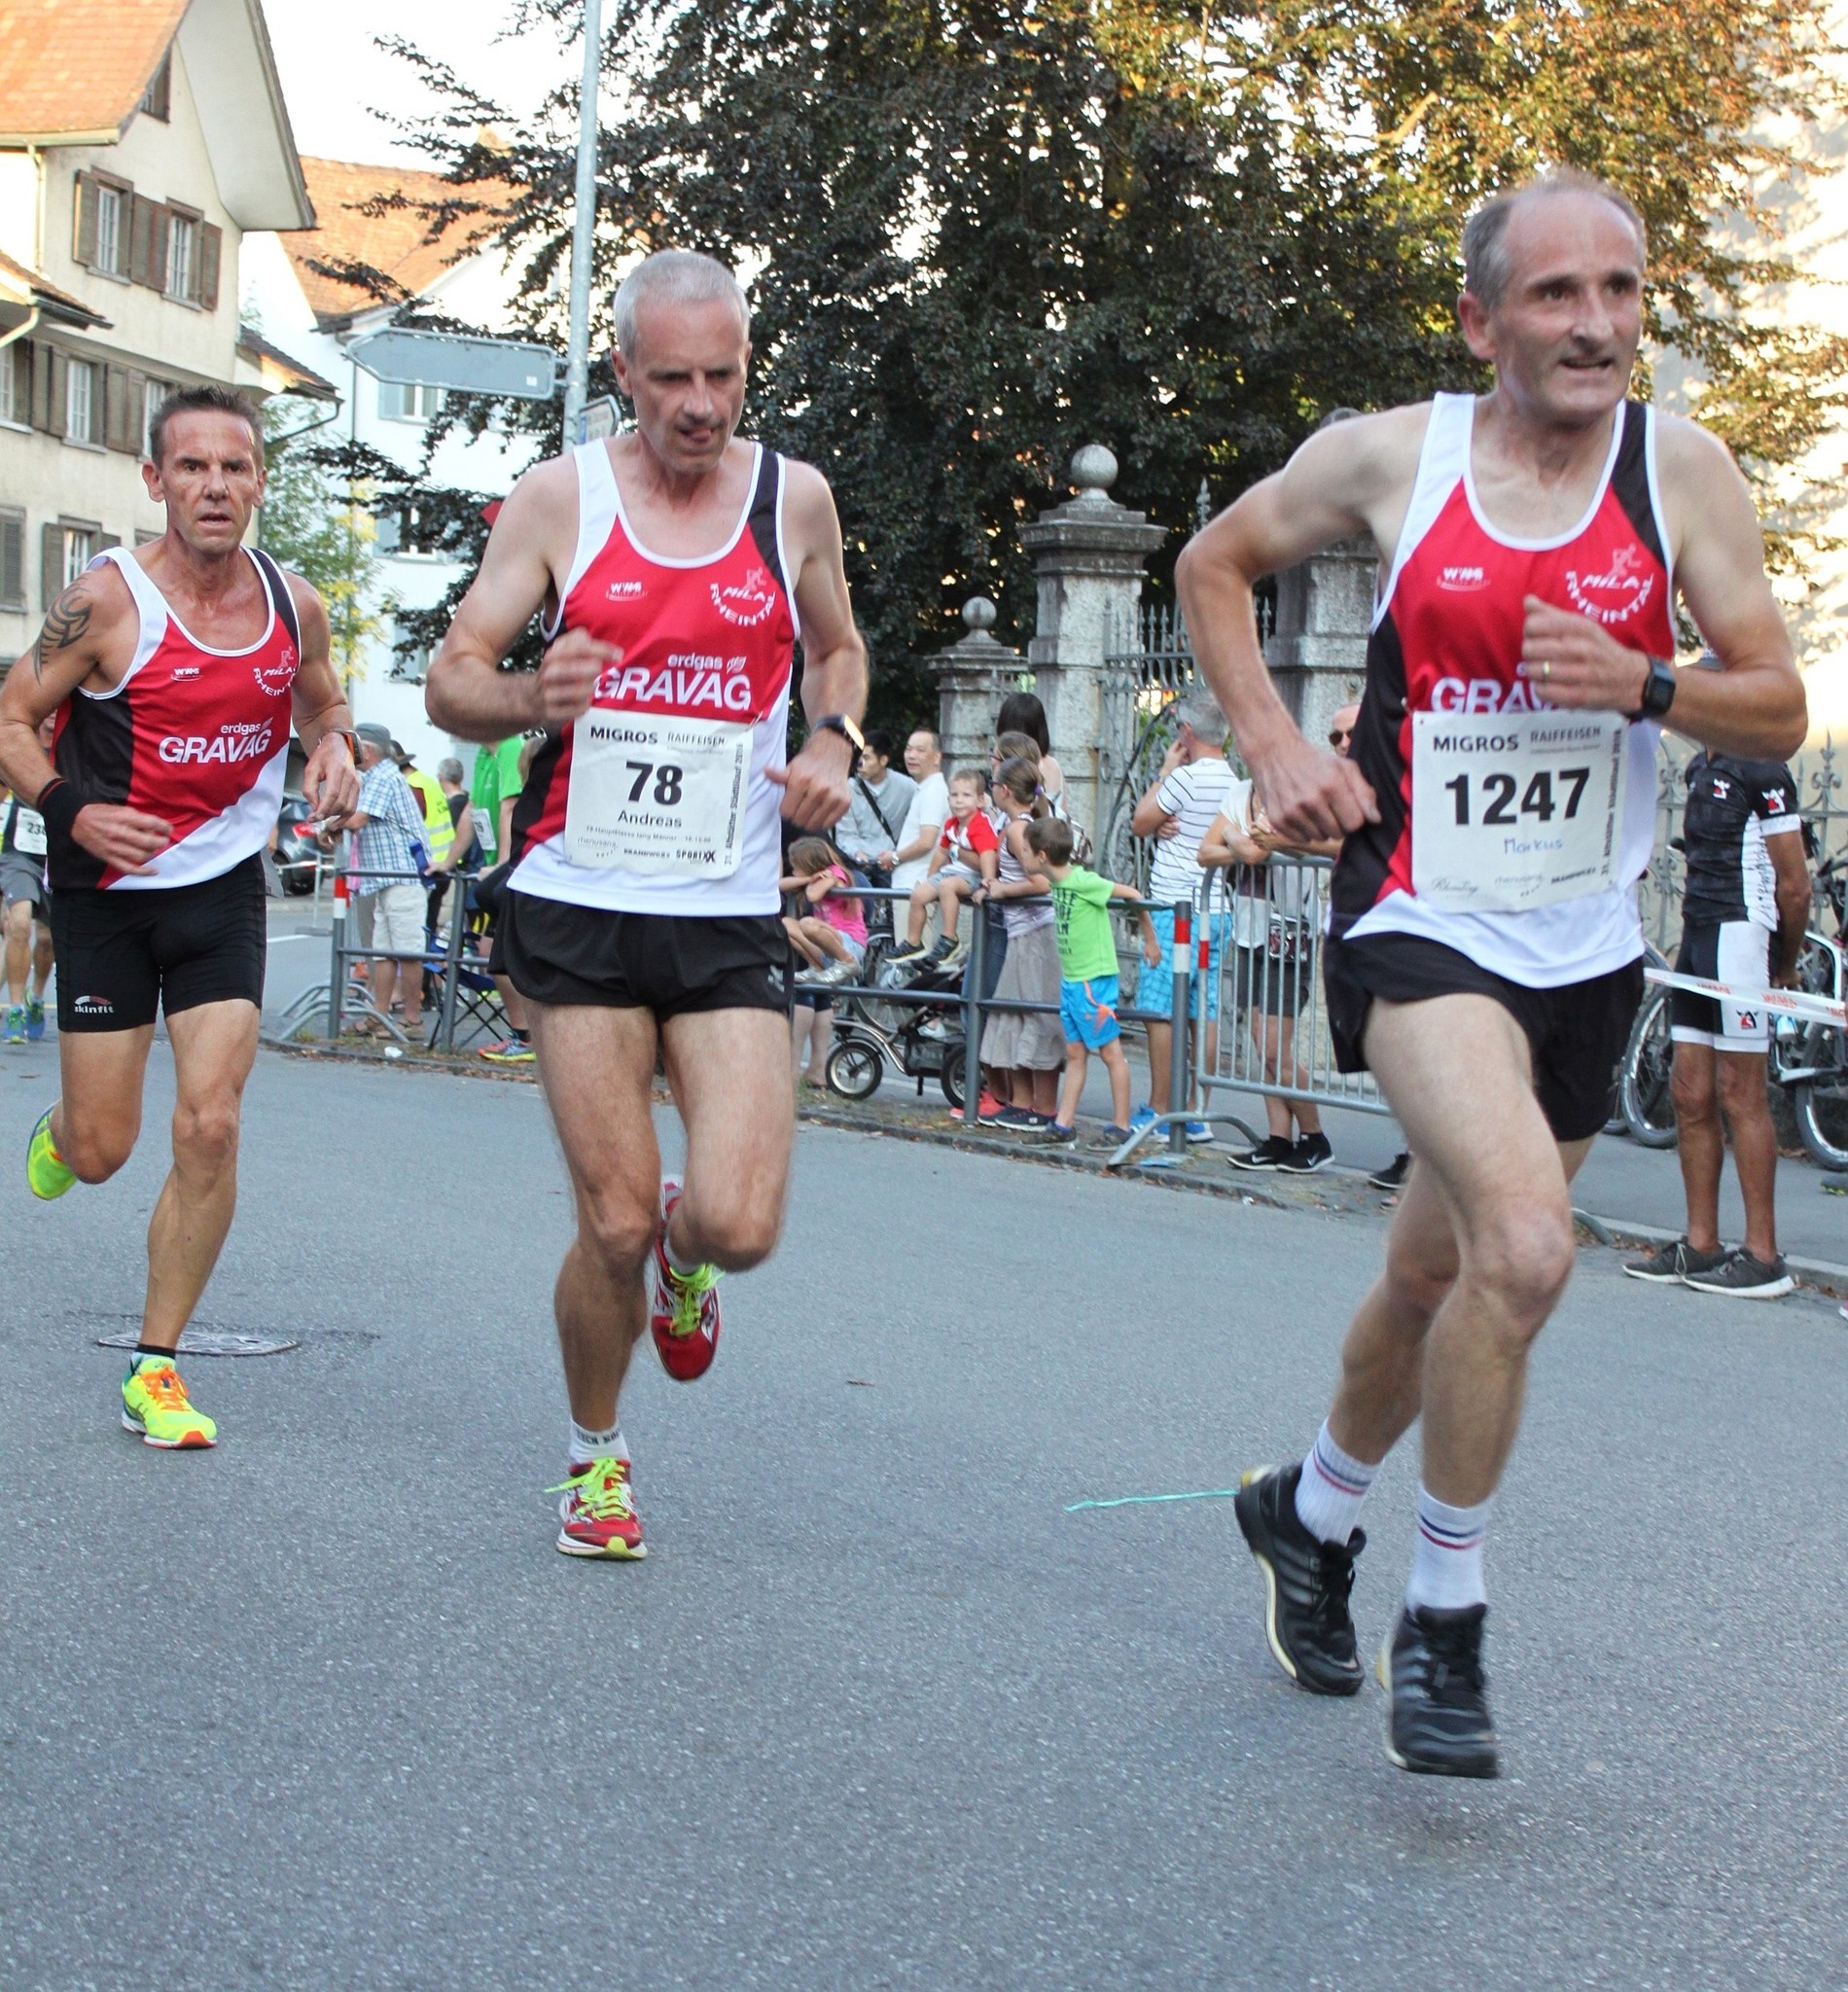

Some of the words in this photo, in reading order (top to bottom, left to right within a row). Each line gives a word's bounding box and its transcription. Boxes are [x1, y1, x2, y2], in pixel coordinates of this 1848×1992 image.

[667, 653, 723, 671] erdgas
[593, 666, 752, 711] GRAVAG
[1431, 676, 1553, 716] GRAV
[221, 722, 261, 736] erdgas
[589, 726, 658, 745] MIGROS
[667, 732, 726, 747] RAIFFEISEN
[1433, 734, 1519, 753] MIGROS
[1530, 726, 1601, 744] RAIFFEISEN
[159, 729, 272, 764] GRAVAG
[625, 760, 684, 806] 78
[1445, 765, 1591, 827] 1247
[618, 809, 682, 828] Andreas
[1504, 837, 1564, 855] Markus
